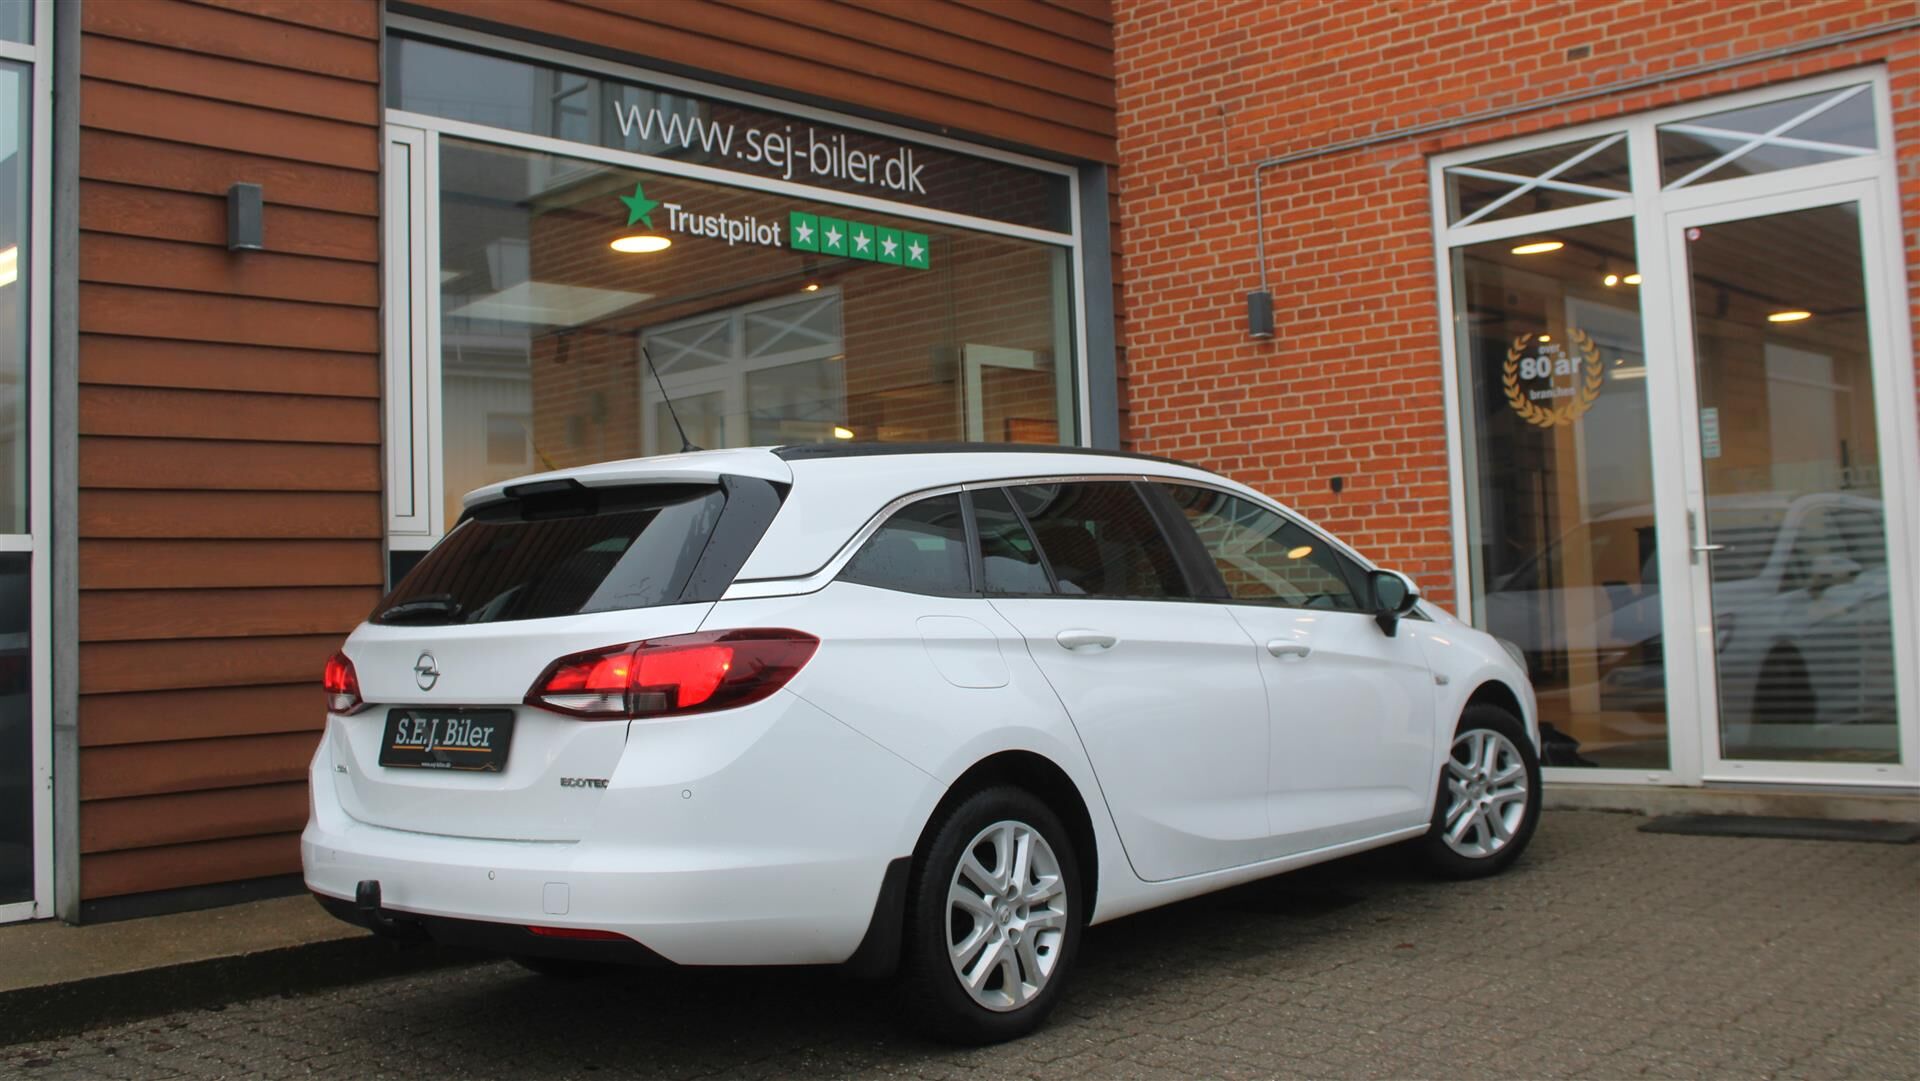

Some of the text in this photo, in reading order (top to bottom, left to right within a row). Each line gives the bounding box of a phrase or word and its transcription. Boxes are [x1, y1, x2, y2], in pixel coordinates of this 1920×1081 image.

[614, 100, 927, 195] www.sej-biler.dk
[663, 202, 782, 247] Trustpilot
[1520, 352, 1582, 380] 80 år
[395, 717, 493, 752] S.E.J. Biler
